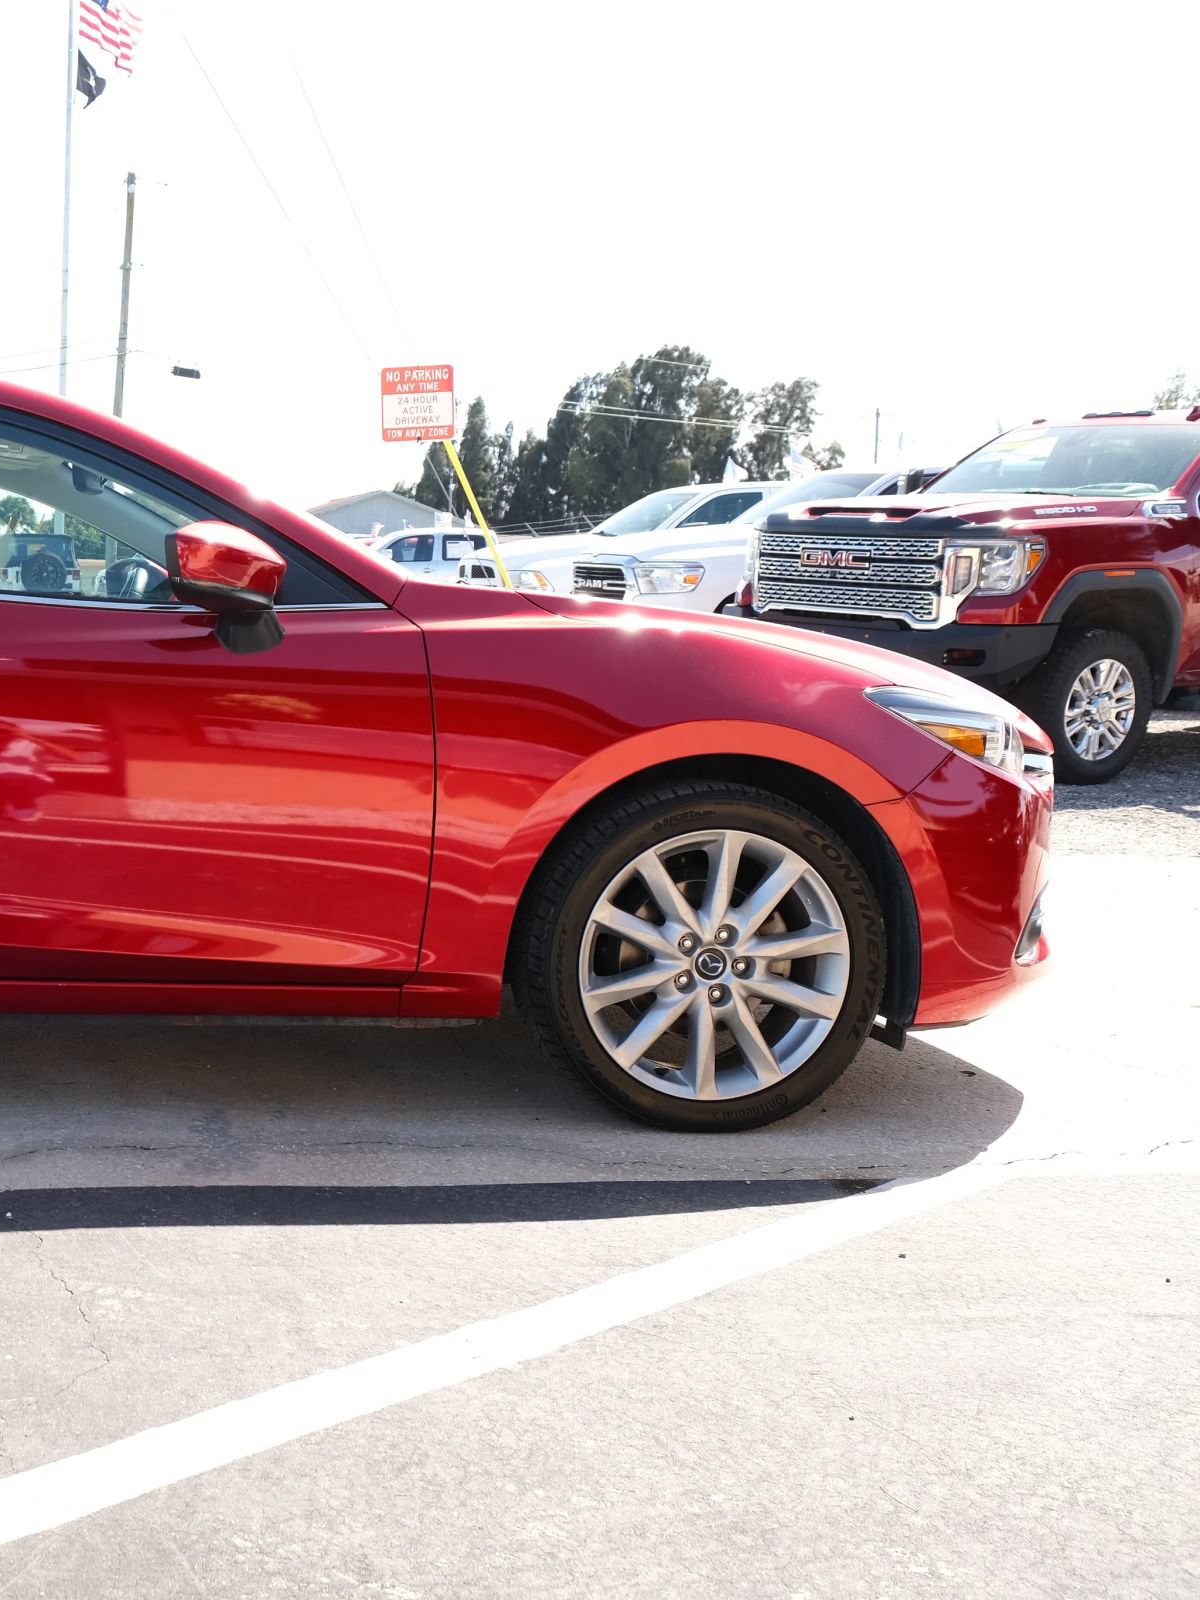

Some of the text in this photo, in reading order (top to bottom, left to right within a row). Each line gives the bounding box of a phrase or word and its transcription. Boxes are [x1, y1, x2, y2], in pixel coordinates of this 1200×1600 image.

[386, 368, 449, 382] NO PARKING
[396, 381, 439, 392] ANY TIME
[398, 395, 438, 405] 24 HOUR
[402, 405, 433, 415] ACTIVE
[395, 415, 440, 425] DRIVEWAY
[387, 427, 449, 438] TOW AWAY ZONE
[801, 550, 870, 568] GMC
[802, 828, 881, 1041] CONTINENTAL
